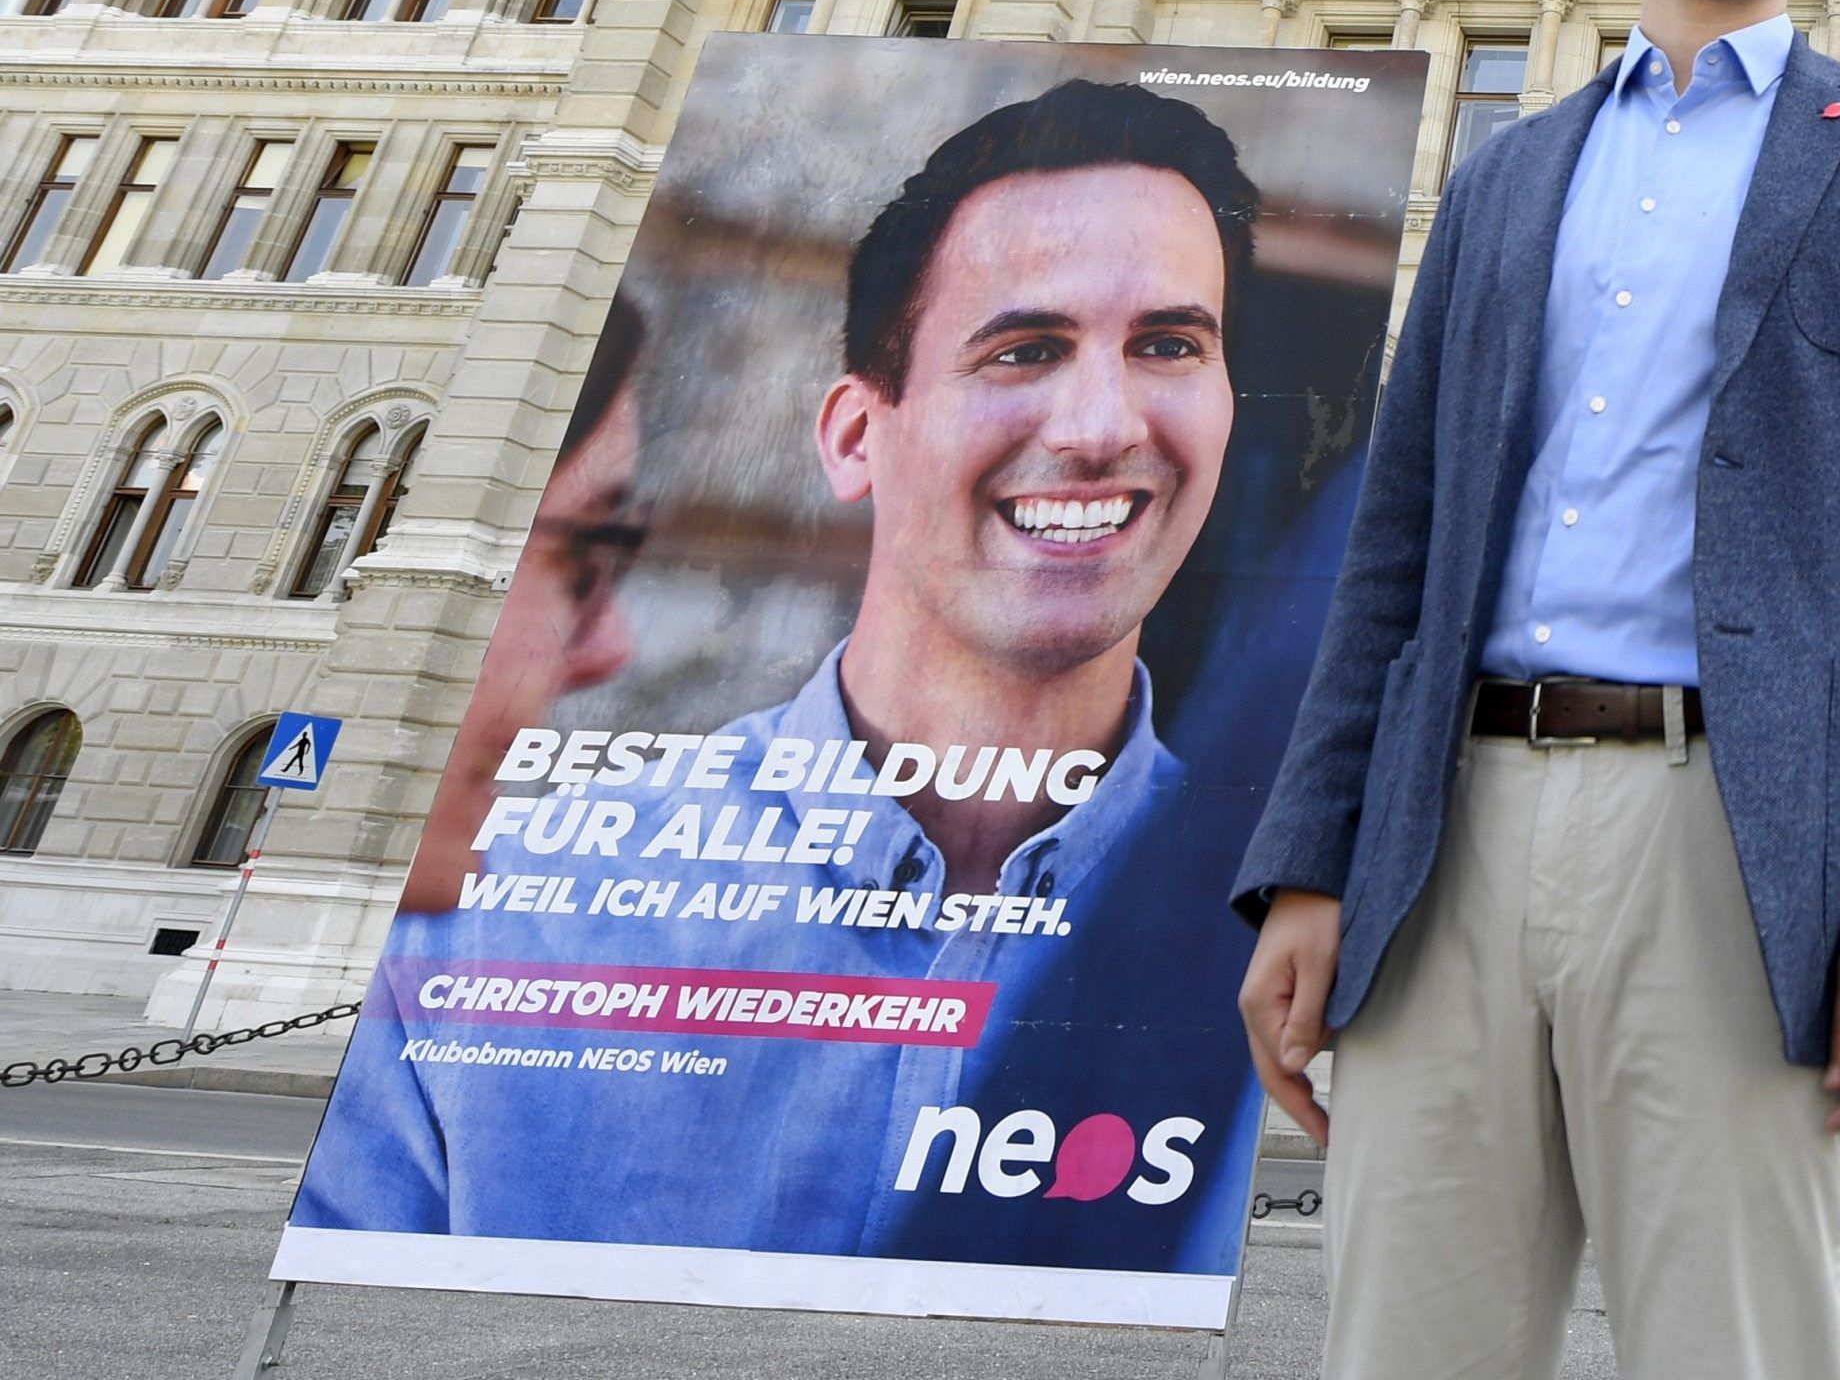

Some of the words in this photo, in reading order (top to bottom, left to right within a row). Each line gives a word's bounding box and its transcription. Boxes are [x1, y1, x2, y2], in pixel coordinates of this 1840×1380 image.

[1139, 68, 1370, 93] wien.neos.eu/bildung
[494, 728, 746, 788] BESTE
[750, 737, 1107, 806] BILDUNG
[470, 782, 636, 857] FÜR
[639, 804, 873, 866] ALLE!
[458, 872, 577, 914] WEIL
[587, 879, 680, 918] ICH
[677, 883, 788, 922] AUF
[795, 886, 932, 930] WIEN
[934, 893, 1072, 936] STEH.
[418, 974, 669, 1019] CHRISTOPH
[675, 985, 967, 1033] WIEDERKEHR
[399, 1039, 573, 1069] Klubobmann
[578, 1047, 656, 1073] NEOS
[660, 1050, 728, 1076] Wien
[895, 1106, 1205, 1205] neos
